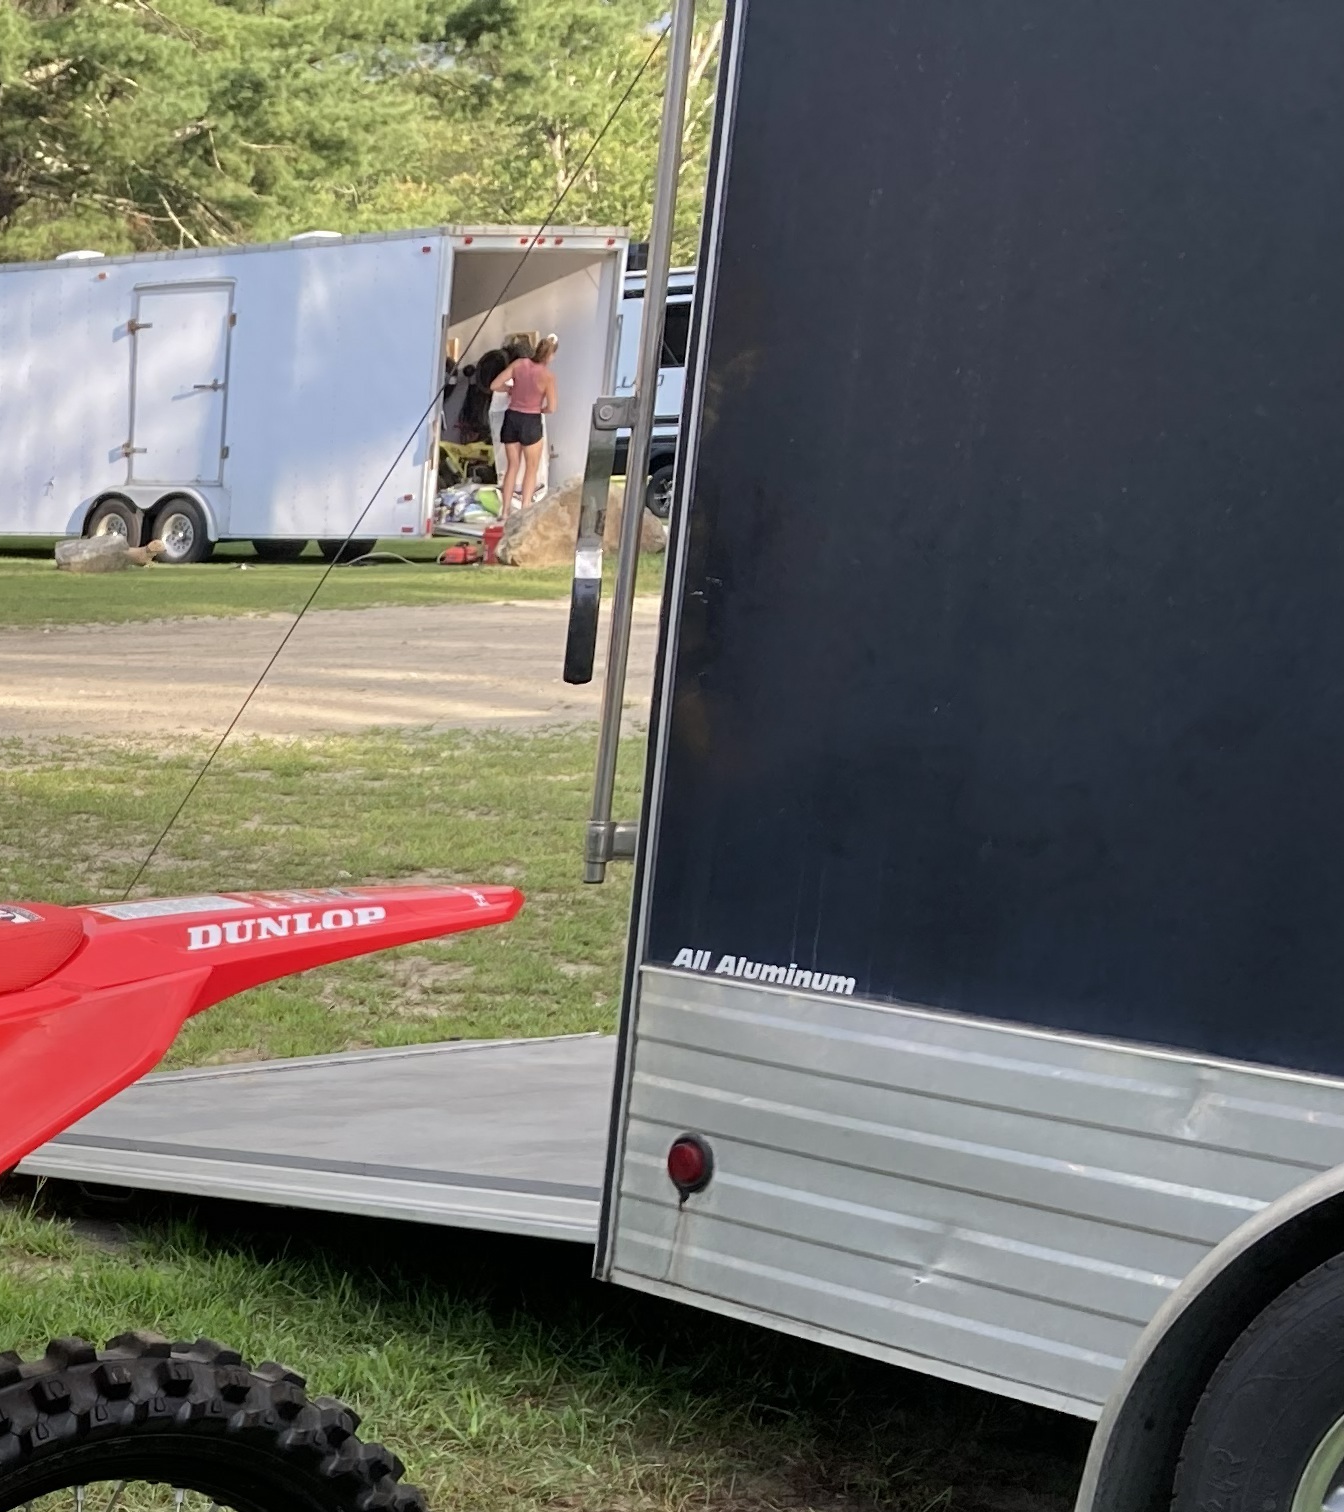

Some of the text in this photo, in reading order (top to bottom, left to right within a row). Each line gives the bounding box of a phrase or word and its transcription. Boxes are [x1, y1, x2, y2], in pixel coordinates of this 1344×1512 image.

[187, 906, 387, 952] DUNLOP
[672, 947, 856, 995] All Aluminum
